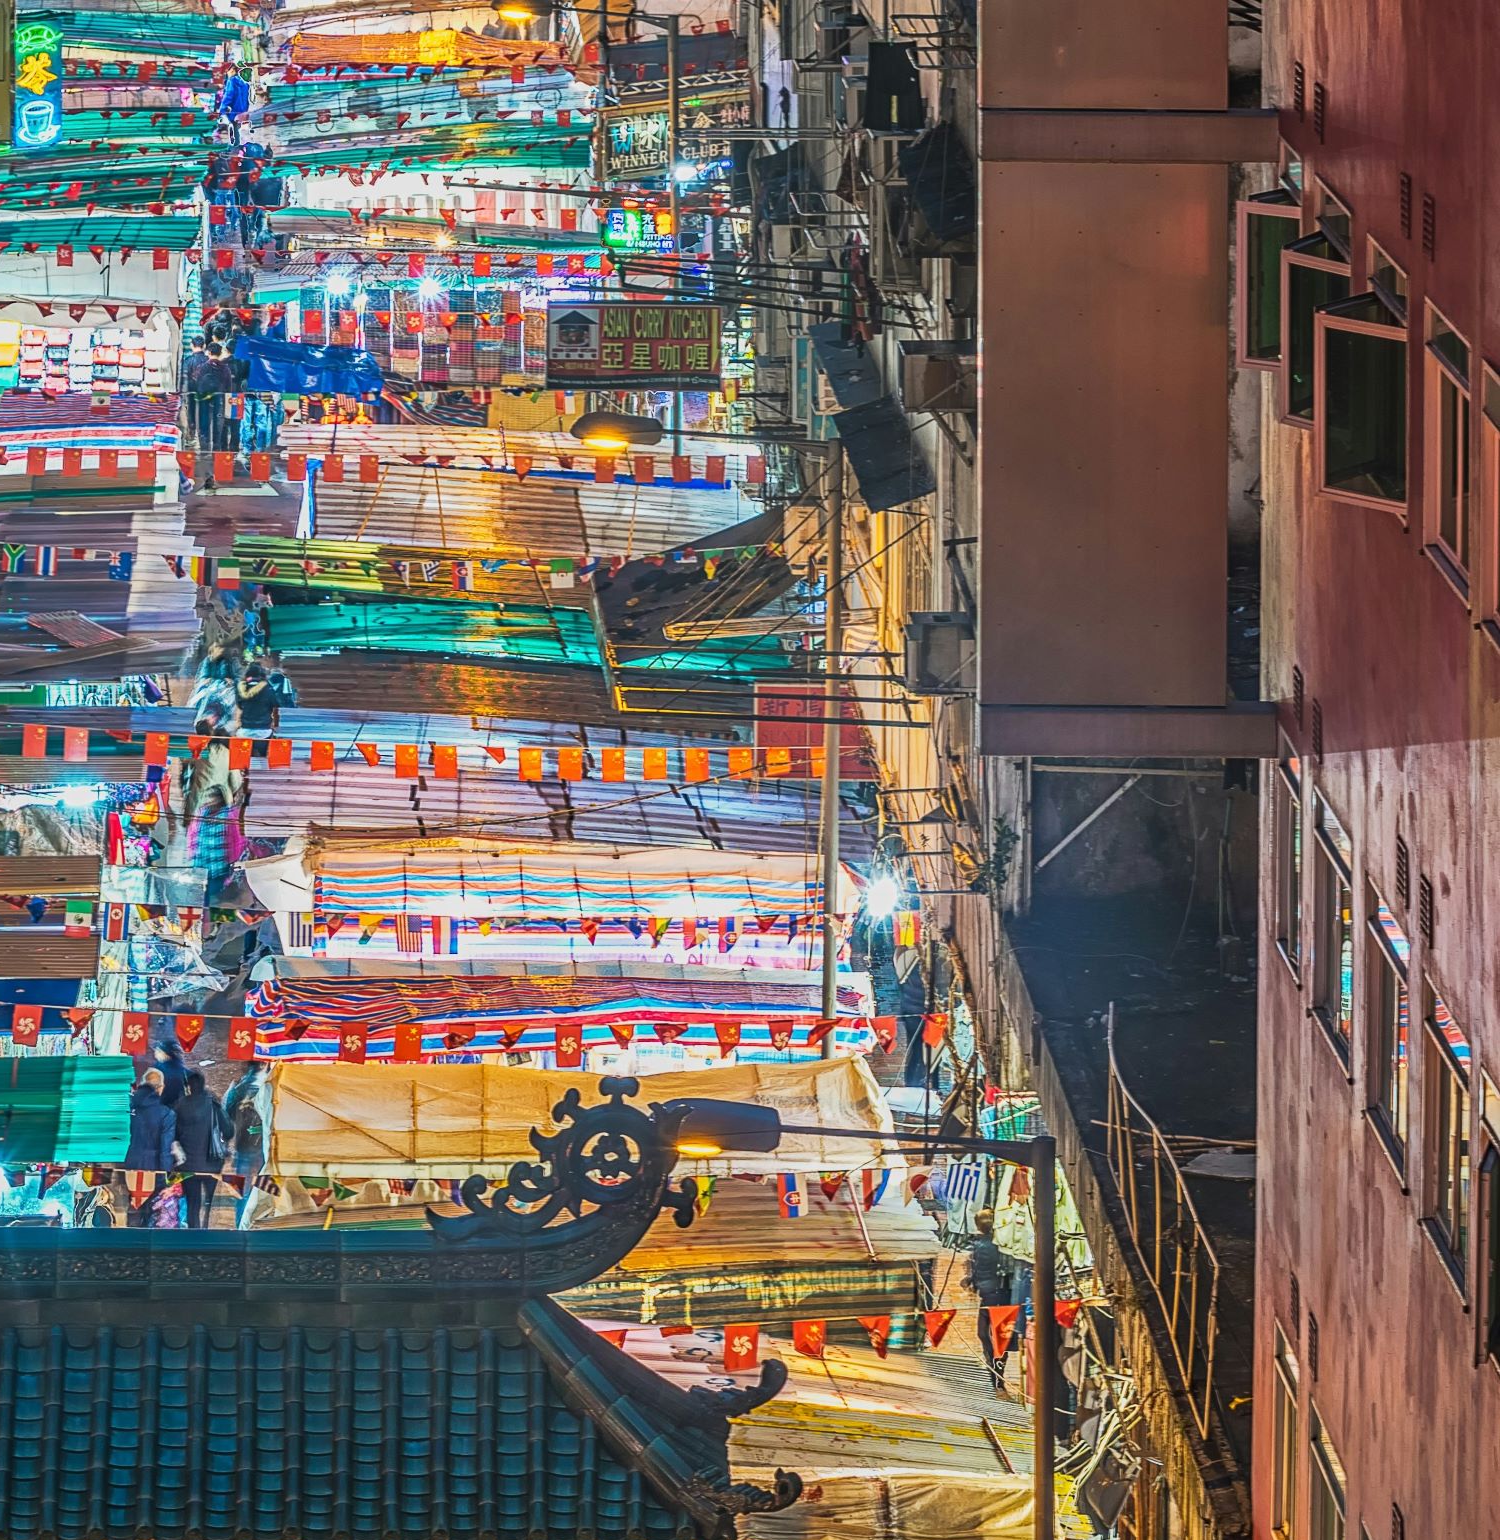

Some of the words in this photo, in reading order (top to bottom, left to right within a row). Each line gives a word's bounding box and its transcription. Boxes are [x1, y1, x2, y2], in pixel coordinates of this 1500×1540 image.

[611, 151, 668, 170] WINNER
[681, 144, 718, 160] CLUB
[602, 309, 630, 338] ASIAN
[634, 309, 665, 338] CURRY
[668, 309, 708, 339] KITCHEN
